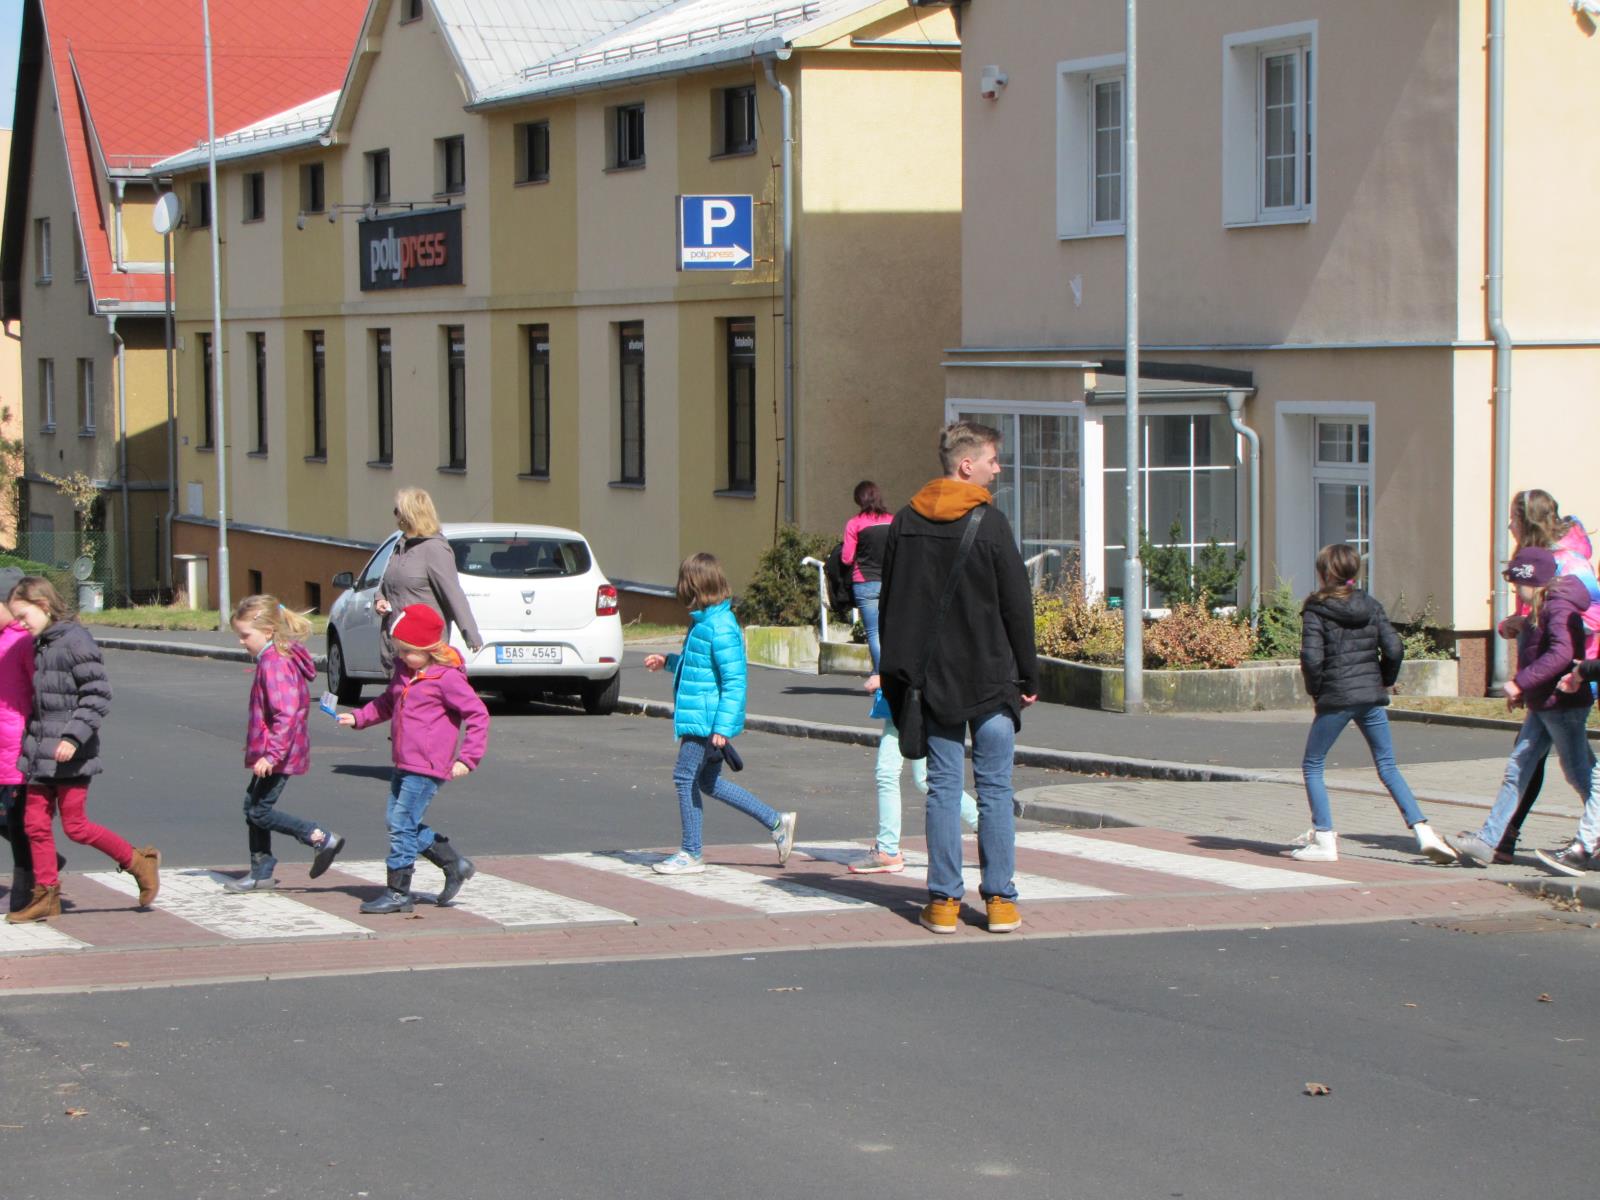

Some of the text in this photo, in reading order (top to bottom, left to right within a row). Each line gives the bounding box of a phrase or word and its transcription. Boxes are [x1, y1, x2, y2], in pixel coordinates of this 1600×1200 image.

[703, 199, 735, 245] P
[370, 227, 447, 283] polypress
[505, 647, 557, 658] 5AS 4545
